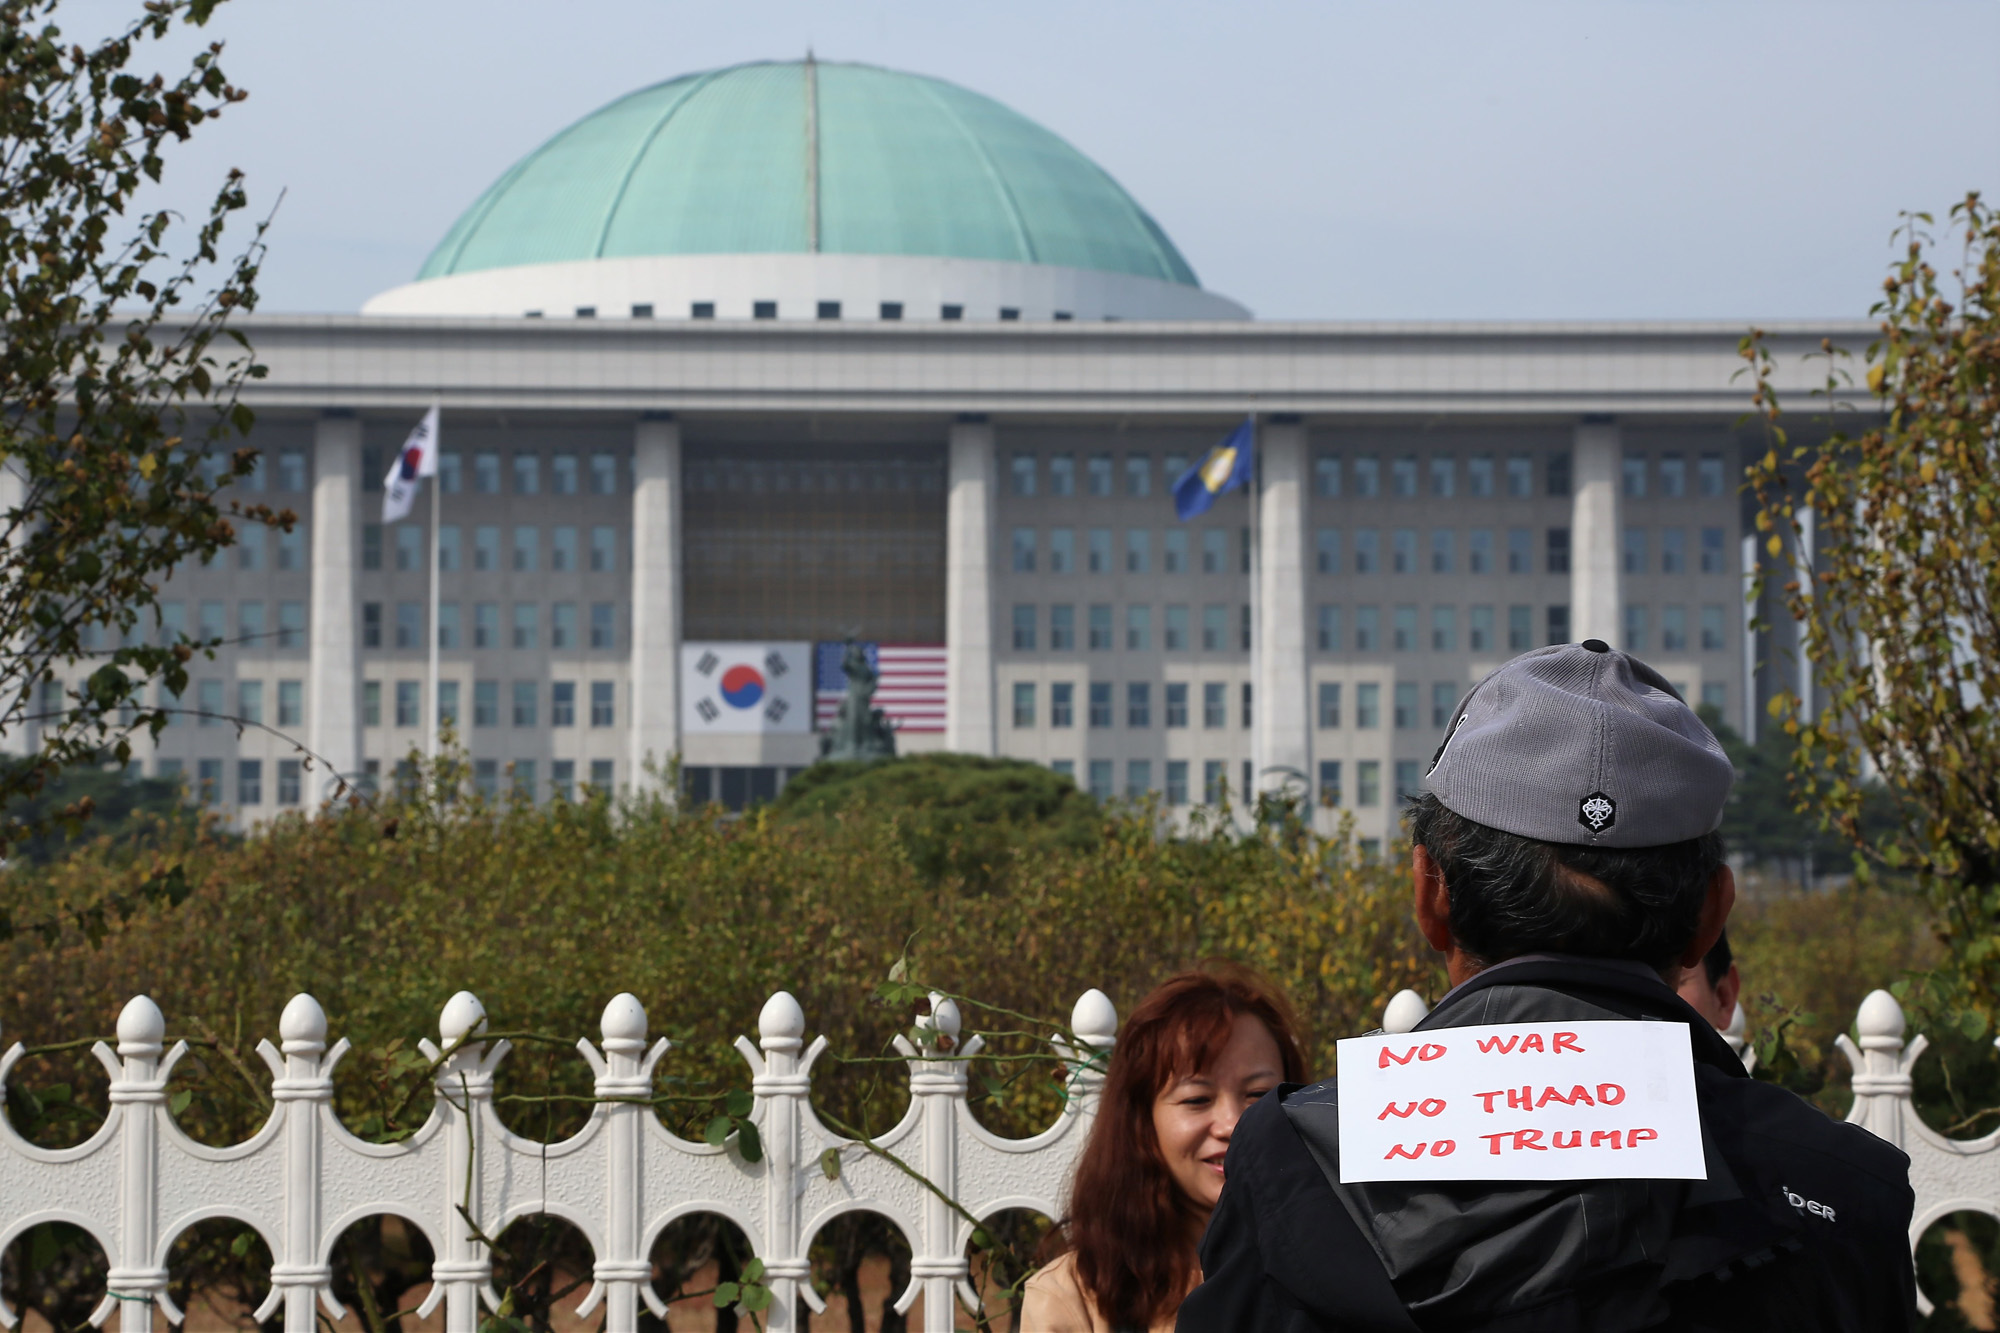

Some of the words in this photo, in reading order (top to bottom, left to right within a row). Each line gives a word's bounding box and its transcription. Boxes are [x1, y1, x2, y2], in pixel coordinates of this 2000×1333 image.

[1378, 1043, 1448, 1069] NO
[1476, 1031, 1586, 1055] WAR
[1377, 1097, 1448, 1121] NO
[1473, 1082, 1627, 1114] THAAD
[1383, 1138, 1457, 1160] NO
[1479, 1127, 1659, 1156] TRUMP
